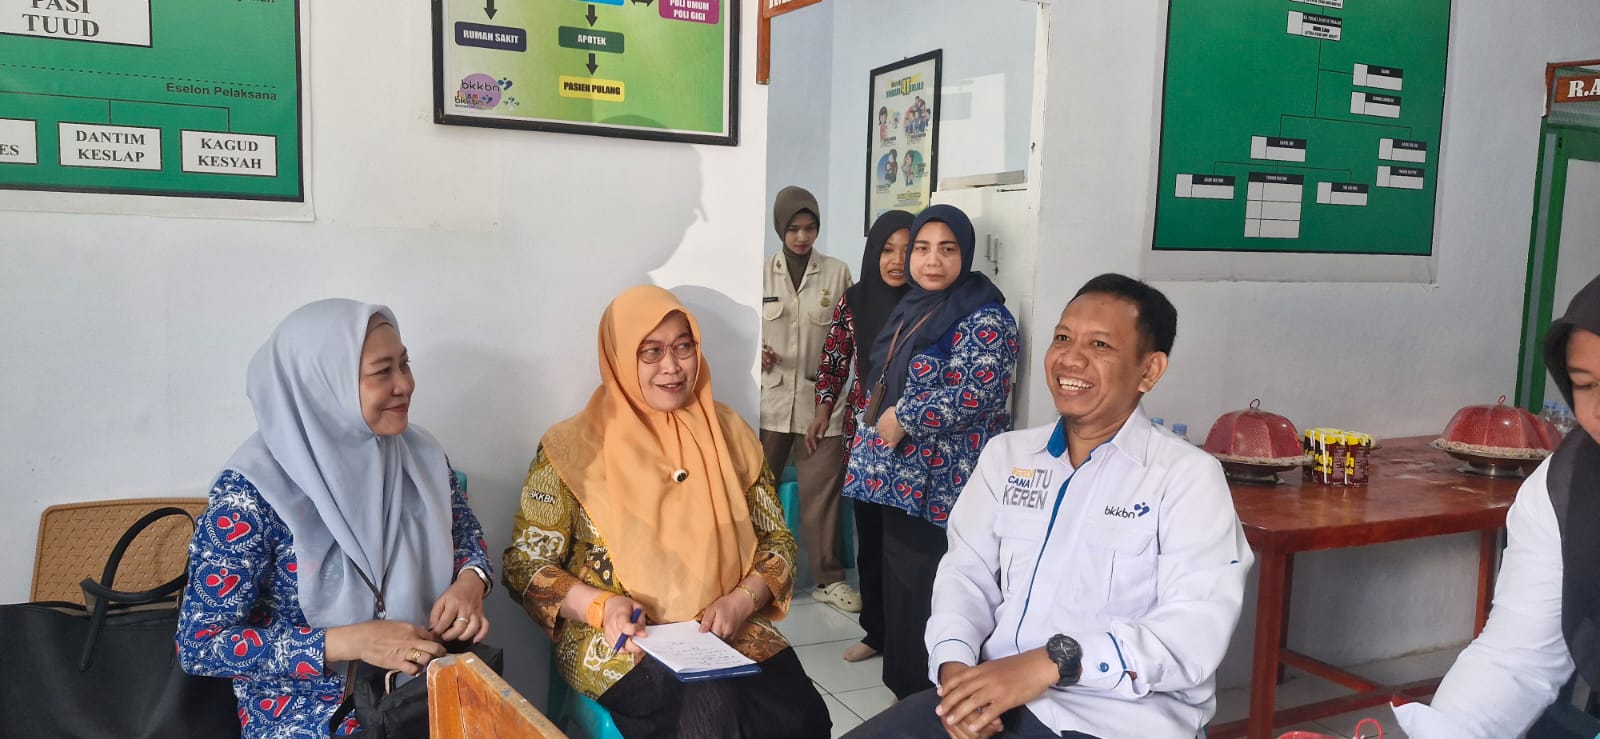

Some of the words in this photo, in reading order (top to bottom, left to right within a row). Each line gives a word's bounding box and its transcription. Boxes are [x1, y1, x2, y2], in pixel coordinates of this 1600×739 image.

[31, 0, 91, 14] PASI
[673, 9, 690, 18] POLI
[691, 11, 706, 21] GIGI
[22, 13, 100, 38] TUUD
[463, 29, 494, 41] RUMAH
[495, 33, 520, 44] SAKIT
[577, 34, 607, 46] APOTEK
[166, 82, 210, 95] Eselon
[213, 86, 277, 101] Pelaksana
[461, 79, 500, 92] bkkbn
[563, 81, 591, 93] PASIEN
[591, 84, 621, 96] PULANG
[76, 130, 145, 146] DANTIM
[201, 137, 259, 152] KAGUD
[78, 148, 145, 163] KESLAP
[198, 155, 262, 169] KESYAH
[1007, 475, 1030, 488] CANA
[1002, 484, 1048, 510] KEREN
[1104, 505, 1135, 519] bkkbn
